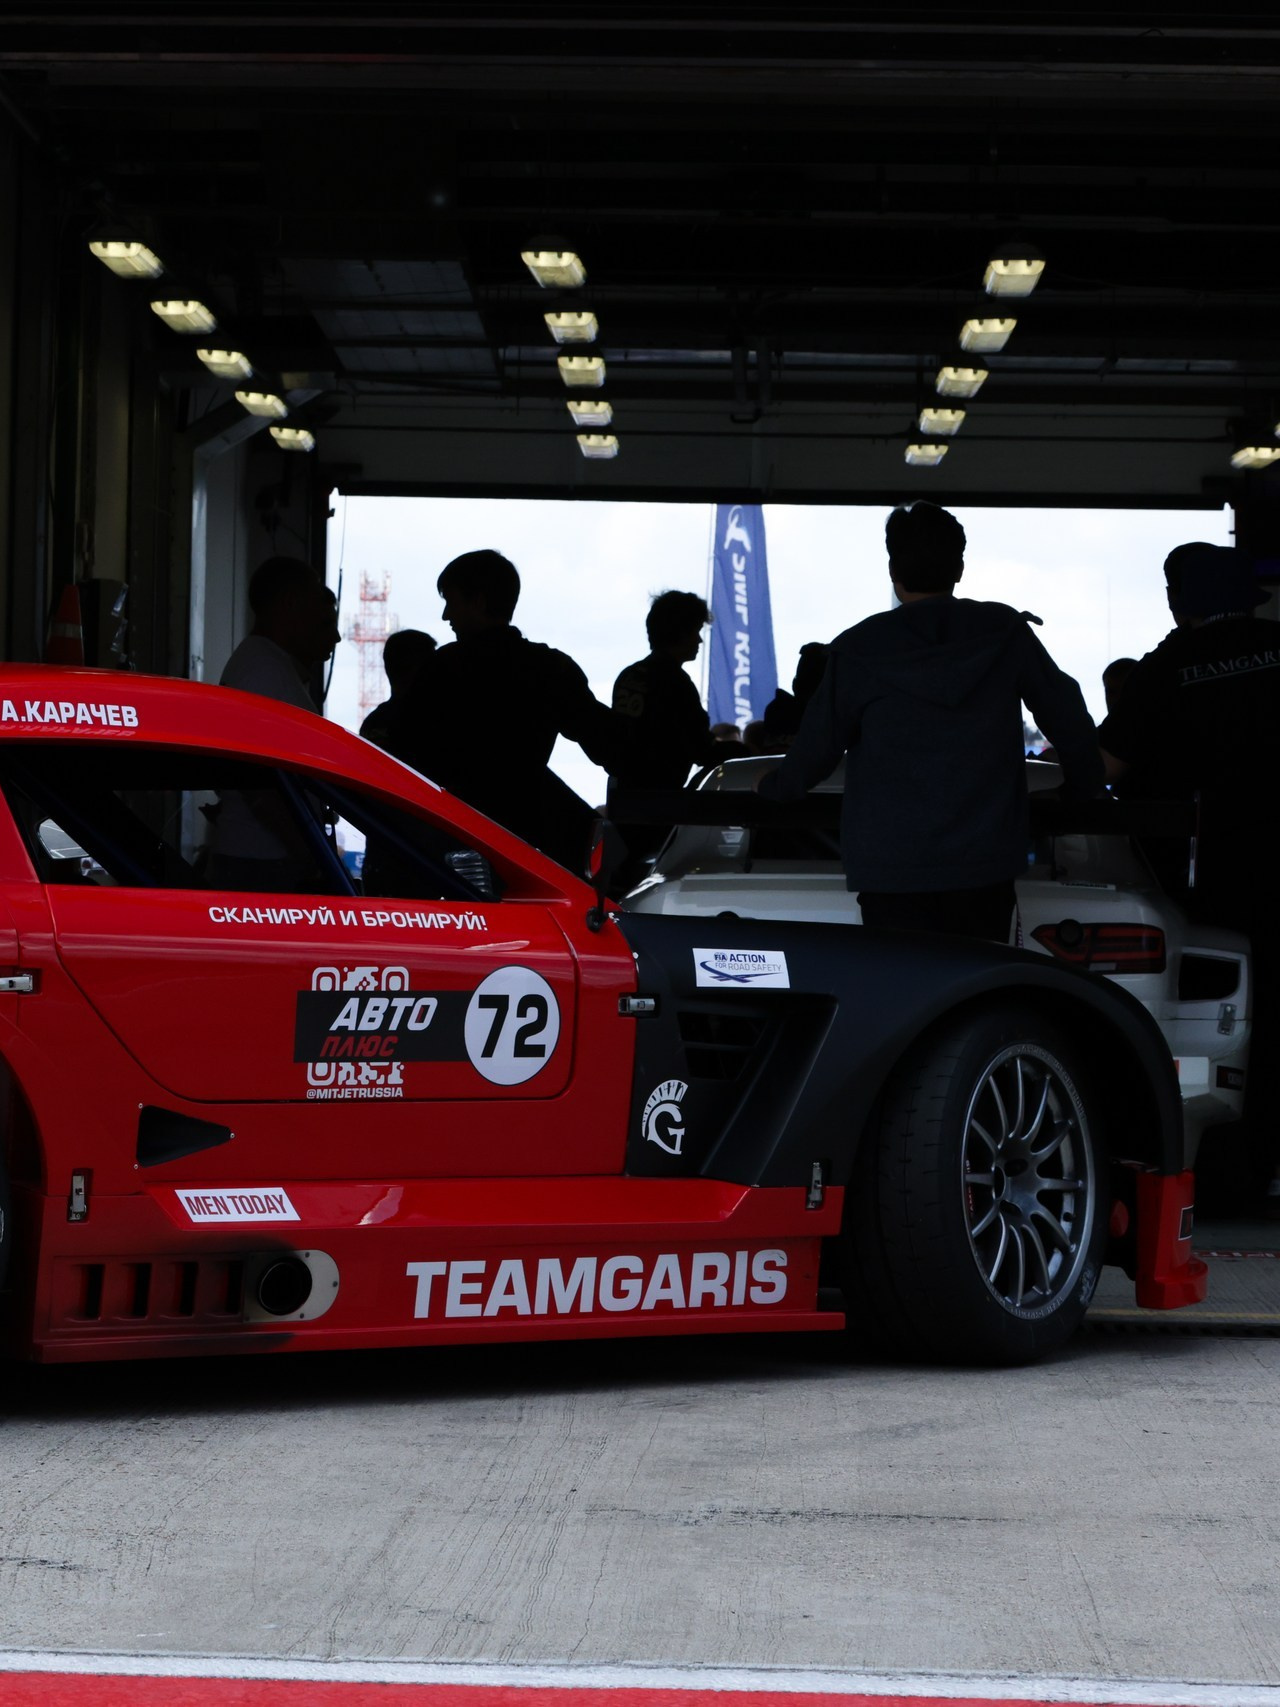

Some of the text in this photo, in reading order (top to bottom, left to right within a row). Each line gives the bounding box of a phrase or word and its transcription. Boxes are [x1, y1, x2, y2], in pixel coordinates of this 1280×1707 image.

[1179, 649, 1280, 681] TEAMGAR
[1, 699, 139, 728] А.КАРАЧЕВ
[208, 905, 488, 931] СКАНИРУЙ И БРОНИРУЙ!
[714, 953, 766, 963] FIA ACTION
[728, 963, 751, 971] ROAD
[752, 963, 782, 972] SAFETY
[329, 997, 438, 1031] АВТО
[477, 993, 549, 1059] 72
[319, 1035, 399, 1057] ПЛЮС
[306, 1087, 404, 1100] @MITJETRUSSIA
[185, 1194, 287, 1216] MEN TODAY
[406, 1249, 789, 1319] TEAMGARIS
